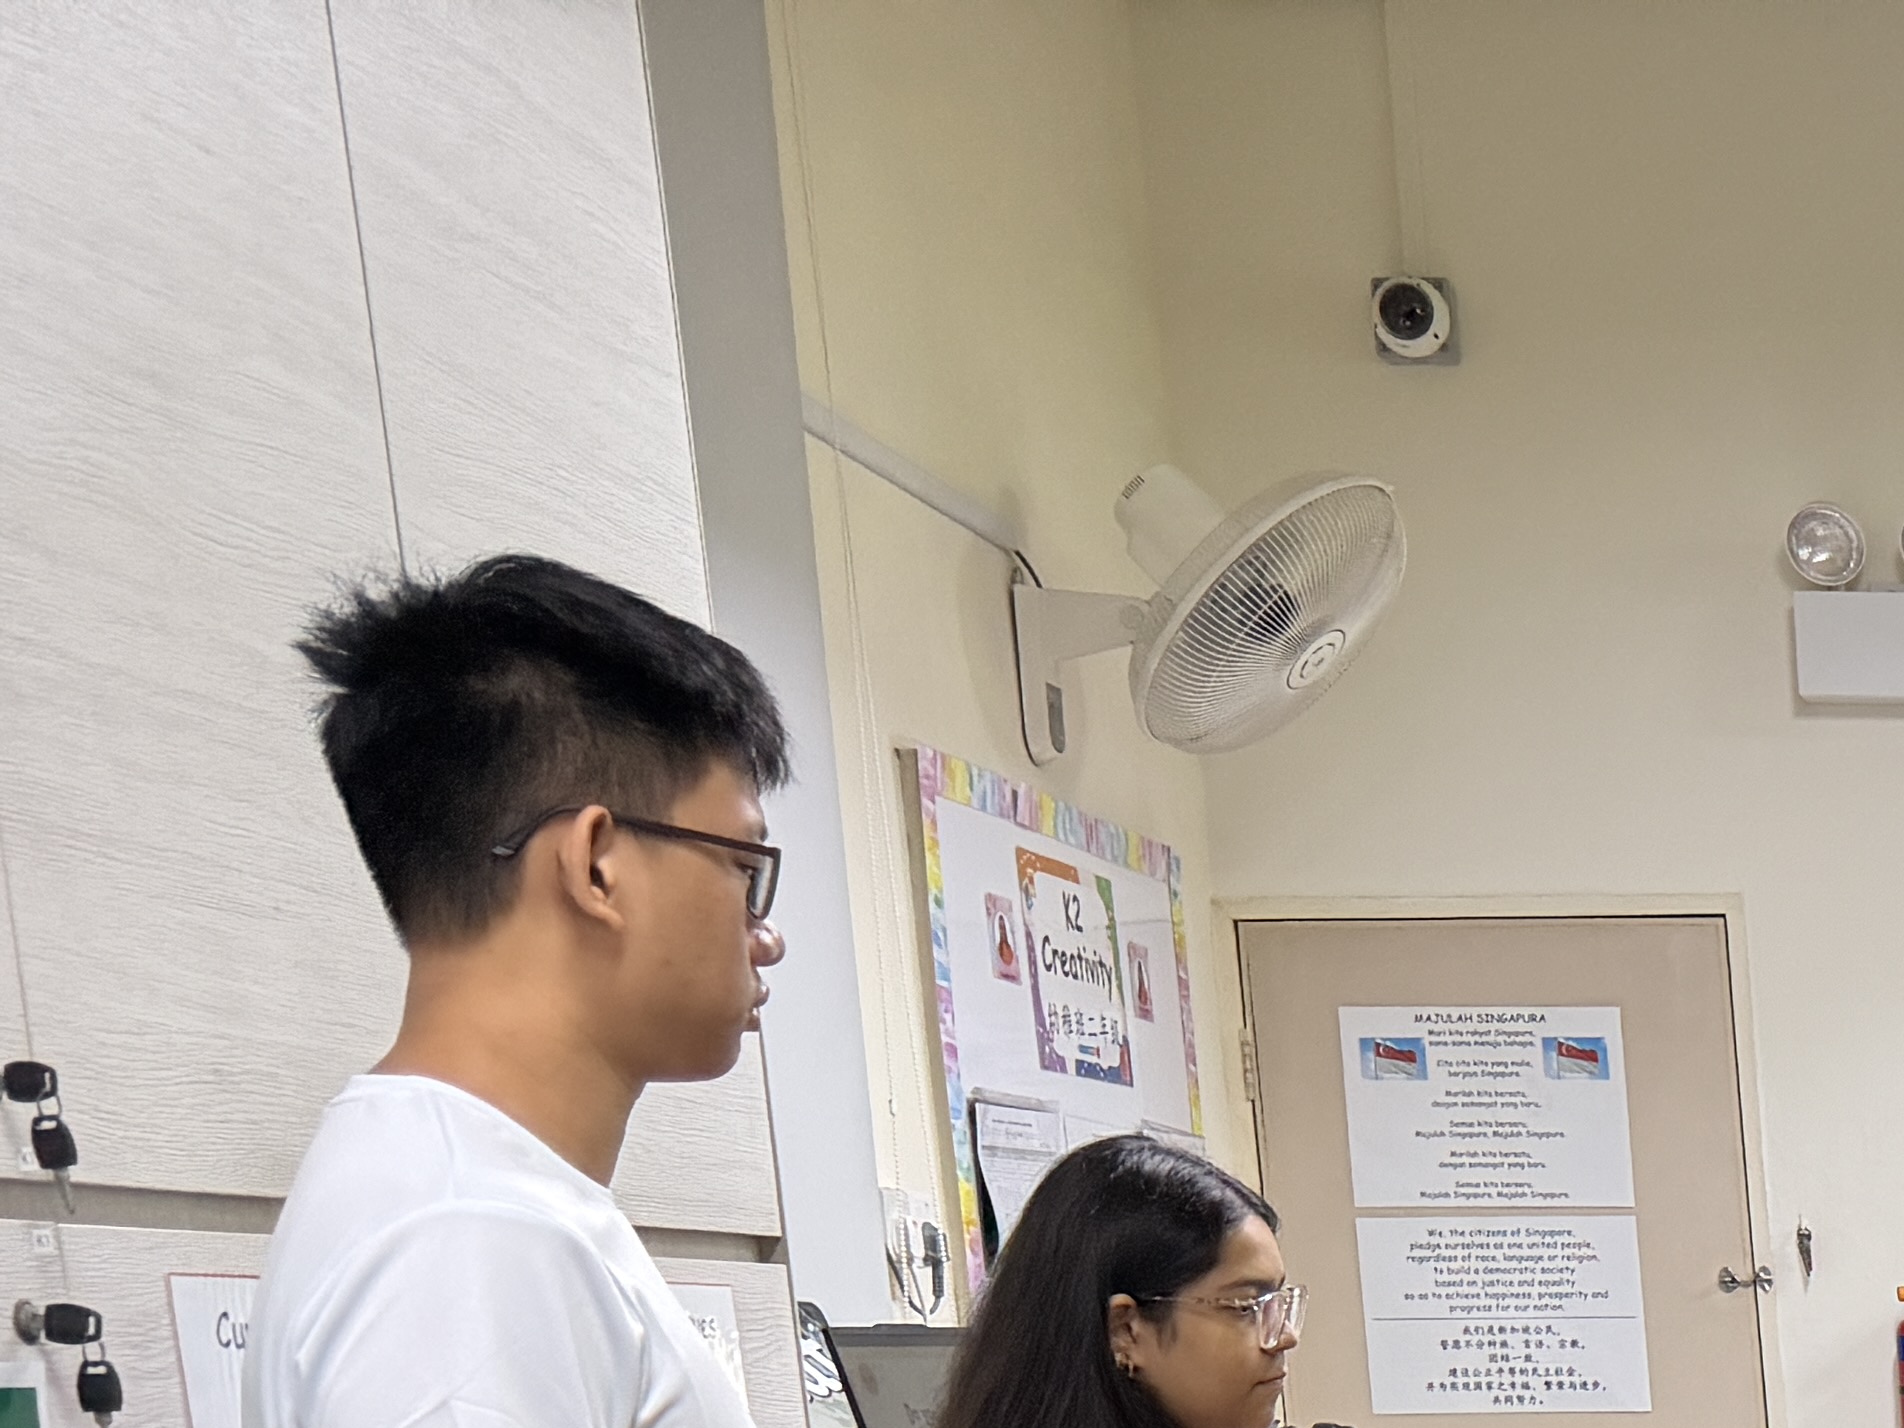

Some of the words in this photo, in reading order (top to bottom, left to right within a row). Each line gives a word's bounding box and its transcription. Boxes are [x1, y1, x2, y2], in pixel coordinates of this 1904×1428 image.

[1062, 890, 1084, 933] K2
[1041, 935, 1115, 1003] Creativity
[1414, 1012, 1473, 1025] MAJULAH
[1477, 1012, 1547, 1025] SINGAPURA
